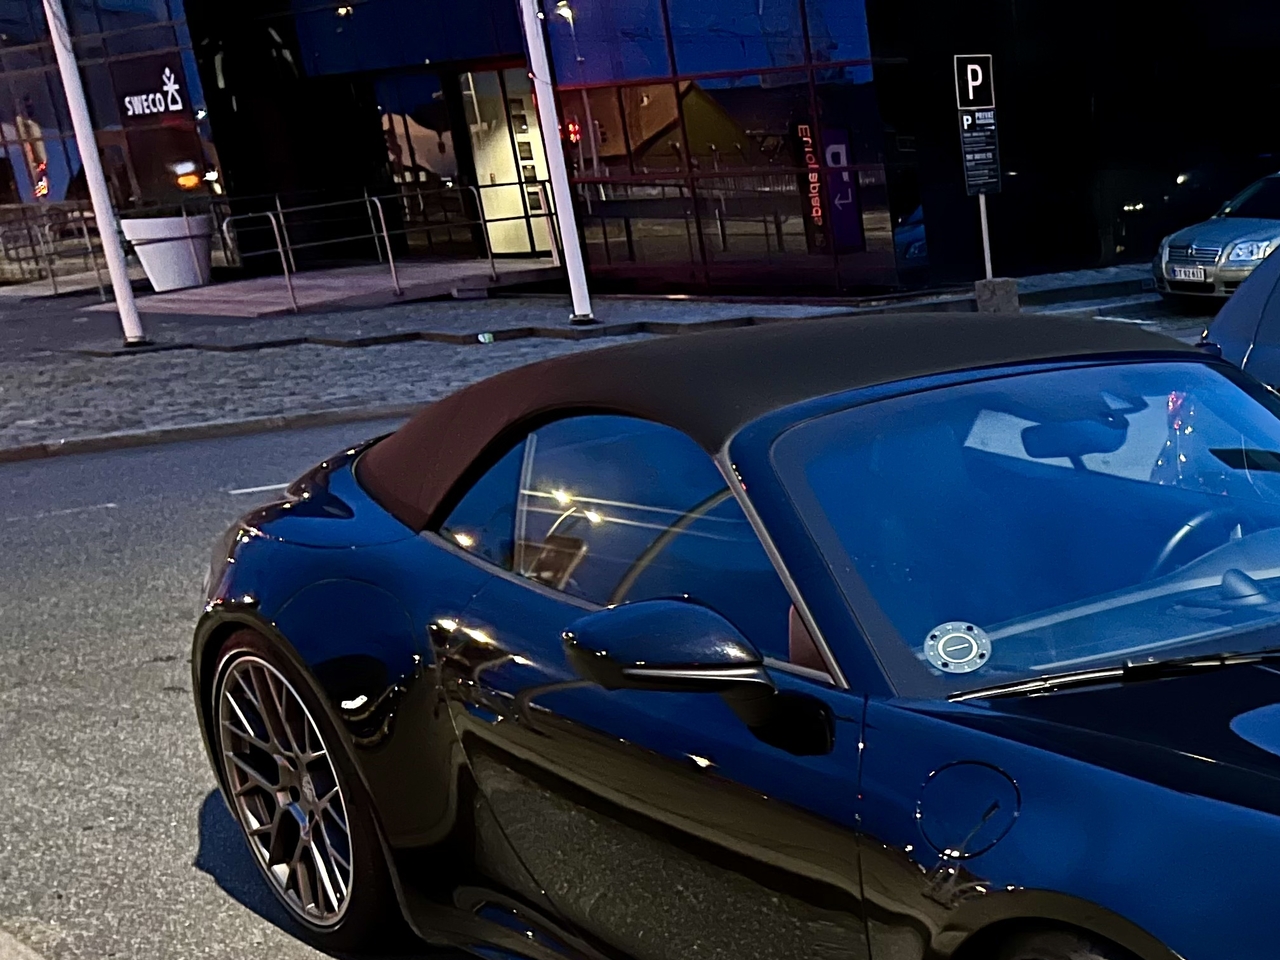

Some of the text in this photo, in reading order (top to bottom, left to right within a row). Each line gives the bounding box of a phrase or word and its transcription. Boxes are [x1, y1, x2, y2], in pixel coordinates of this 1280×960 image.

[967, 64, 983, 100] P
[124, 92, 166, 116] SWECO
[963, 115, 972, 130] P
